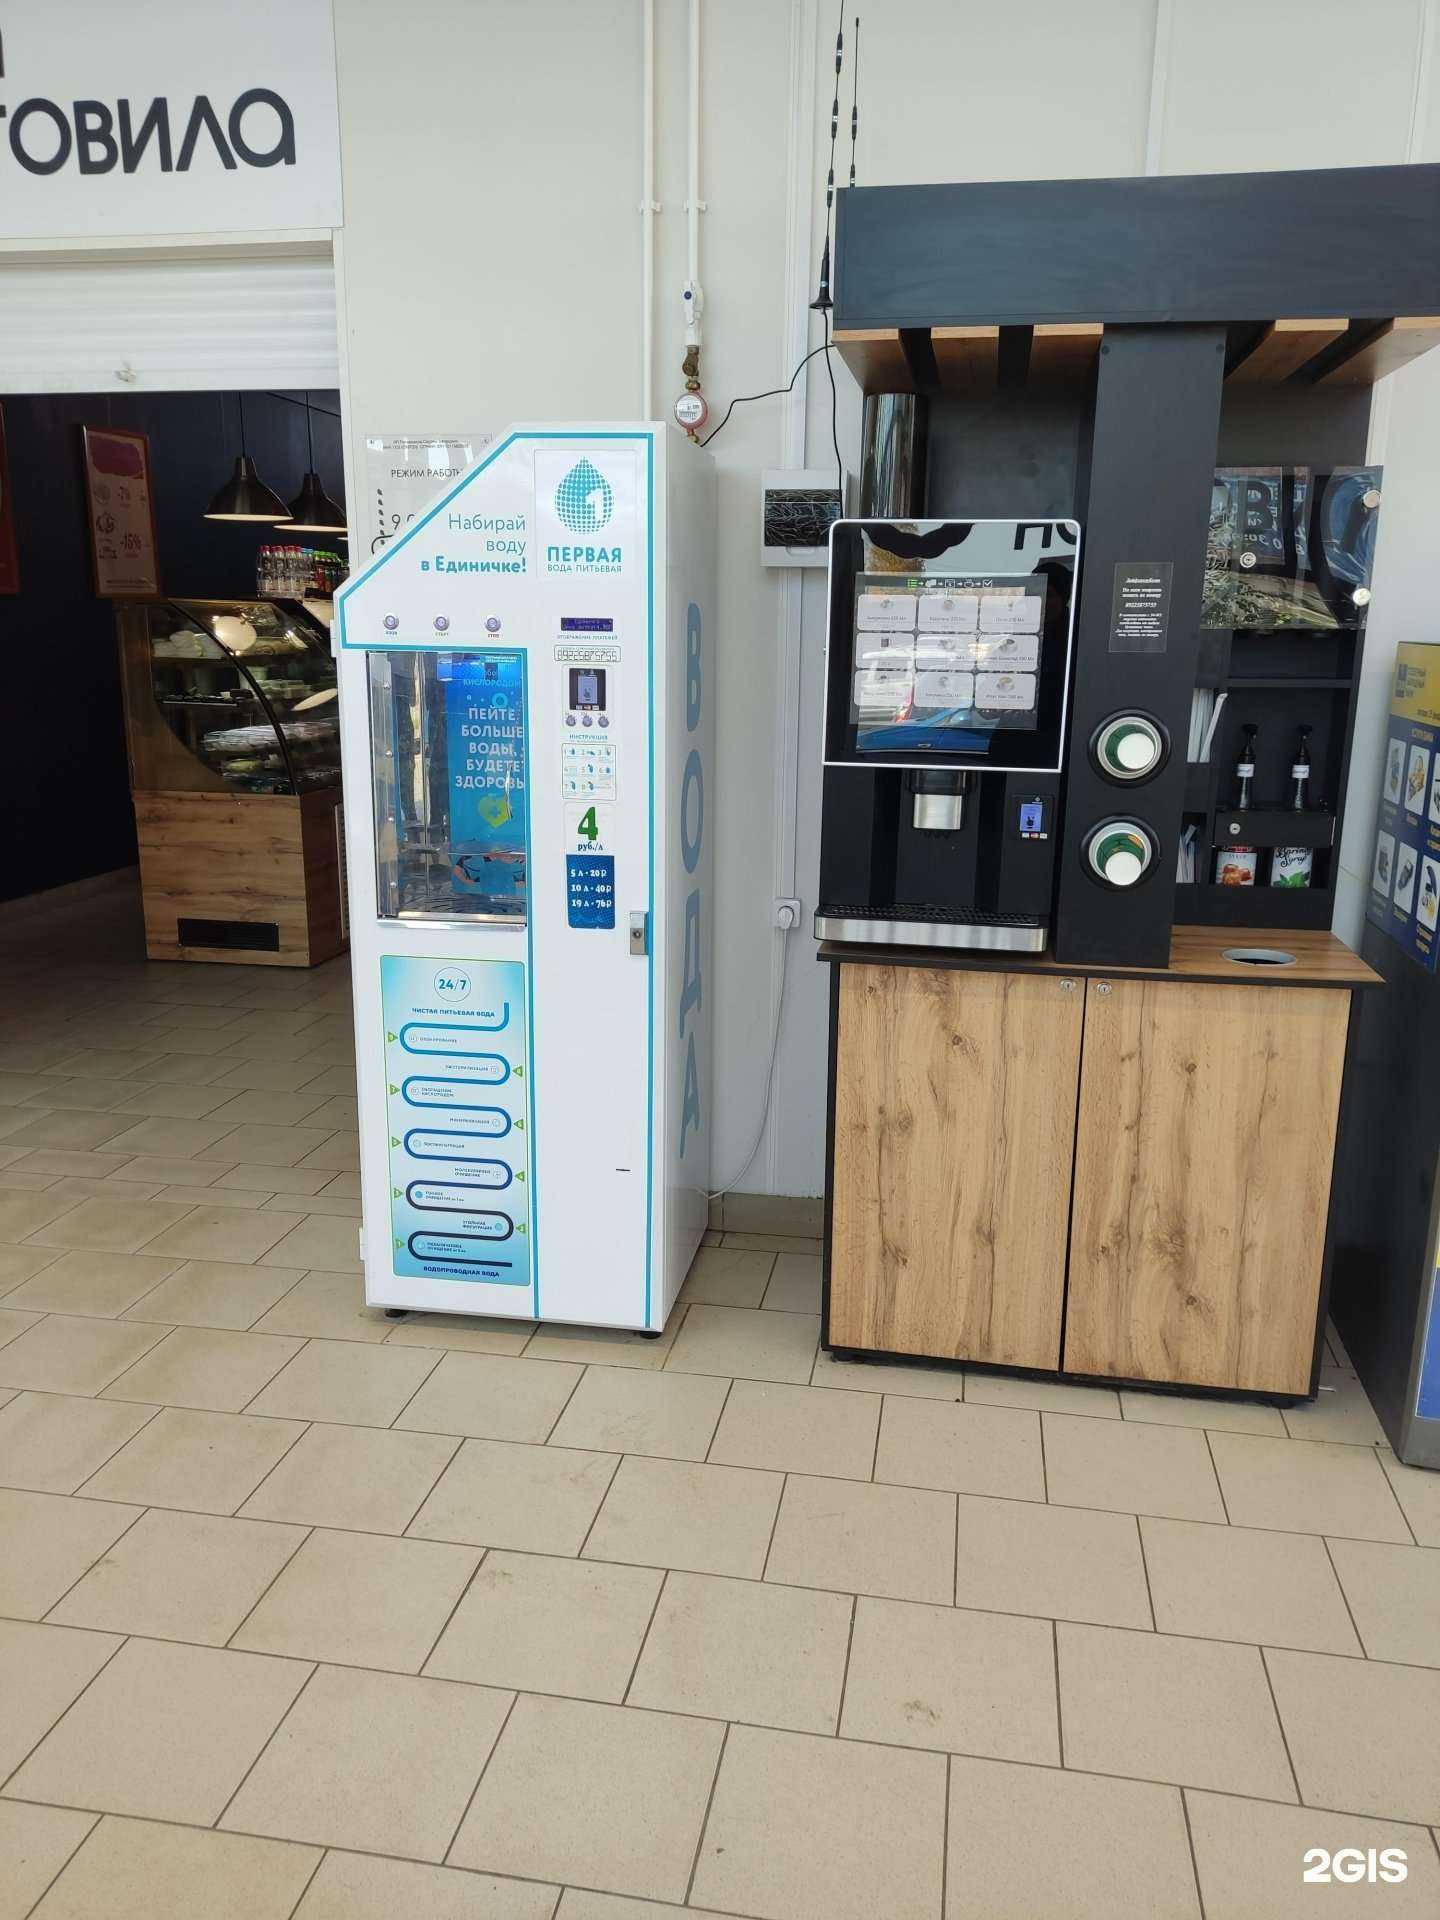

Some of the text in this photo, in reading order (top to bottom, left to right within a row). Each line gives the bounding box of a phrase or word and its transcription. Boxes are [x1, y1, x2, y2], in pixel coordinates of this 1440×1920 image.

[391, 469, 425, 478] РЕЖИМ
[448, 513, 526, 534] Набирай
[486, 540, 526, 556] воду
[547, 546, 622, 562] ПЕРВАЯ
[421, 555, 526, 573] в Единичке!
[547, 564, 622, 573] ВОДА ПИТЬЕВАЯ
[468, 704, 516, 721] ПЕЙТЕ
[461, 724, 523, 738] БОЛЬШЕ
[469, 742, 517, 757] ВОДЫ,
[466, 759, 521, 773] БУДЕТЕ
[577, 806, 598, 841] 4
[679, 602, 703, 1159] ВОДА
[438, 978, 467, 992] 24/7
[411, 1007, 438, 1015] ЧИСТАЯ
[476, 1010, 495, 1018] ВОДА
[423, 1265, 481, 1276] ВОДОПРОВОДНАЯ
